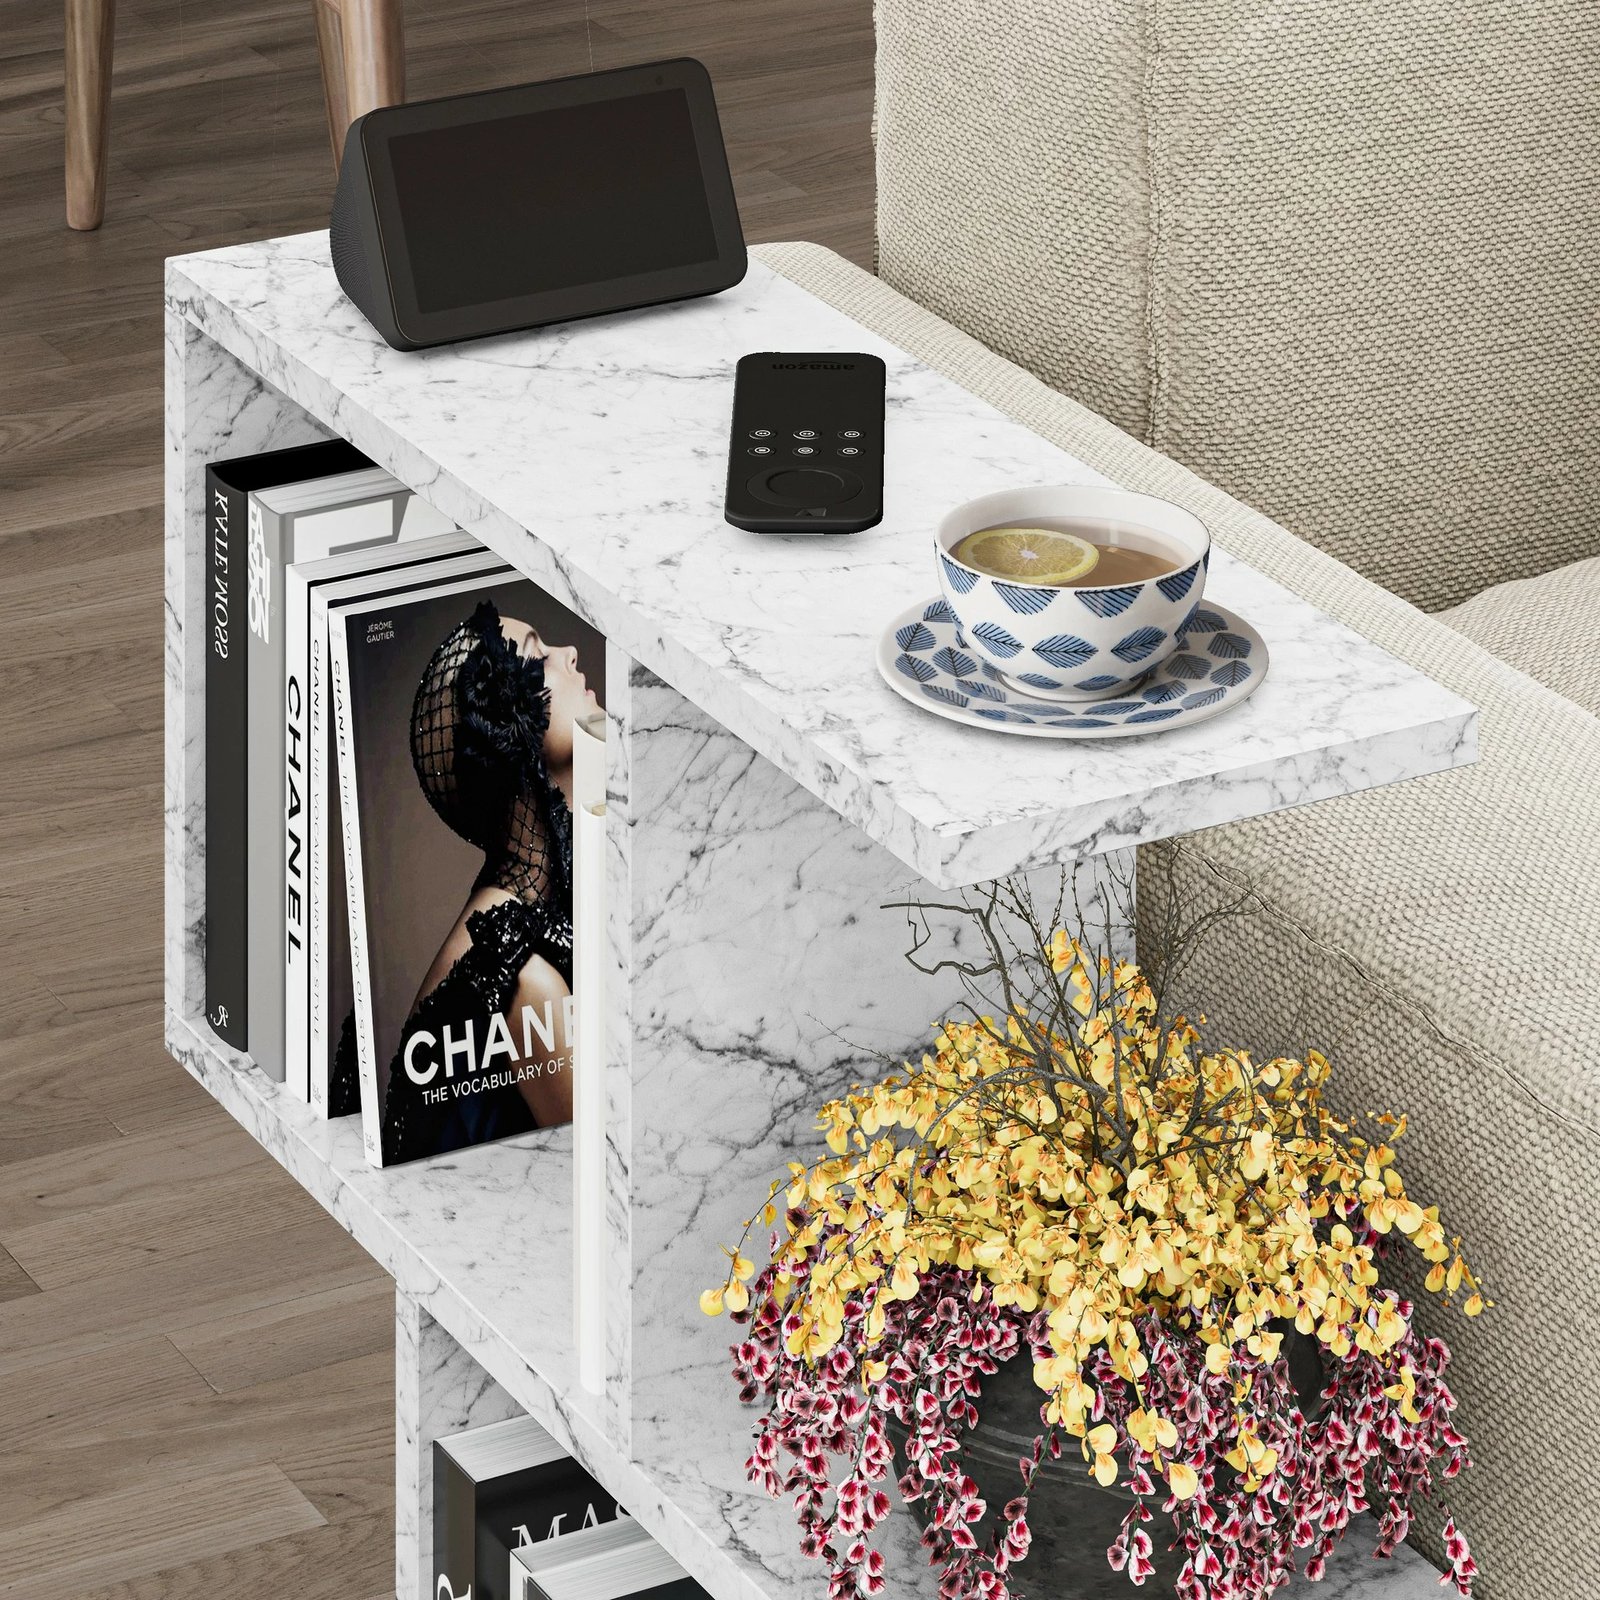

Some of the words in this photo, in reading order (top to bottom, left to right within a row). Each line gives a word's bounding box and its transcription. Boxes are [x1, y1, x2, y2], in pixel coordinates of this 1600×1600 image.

[772, 363, 856, 371] amazon
[366, 631, 395, 644] GAUTIER
[335, 660, 346, 763] CHANEL
[288, 675, 301, 964] CHANEL
[403, 995, 573, 1085] CHANE
[422, 1086, 449, 1106] THE
[452, 1062, 543, 1098] VOCABULARY
[547, 1056, 565, 1075] OF
